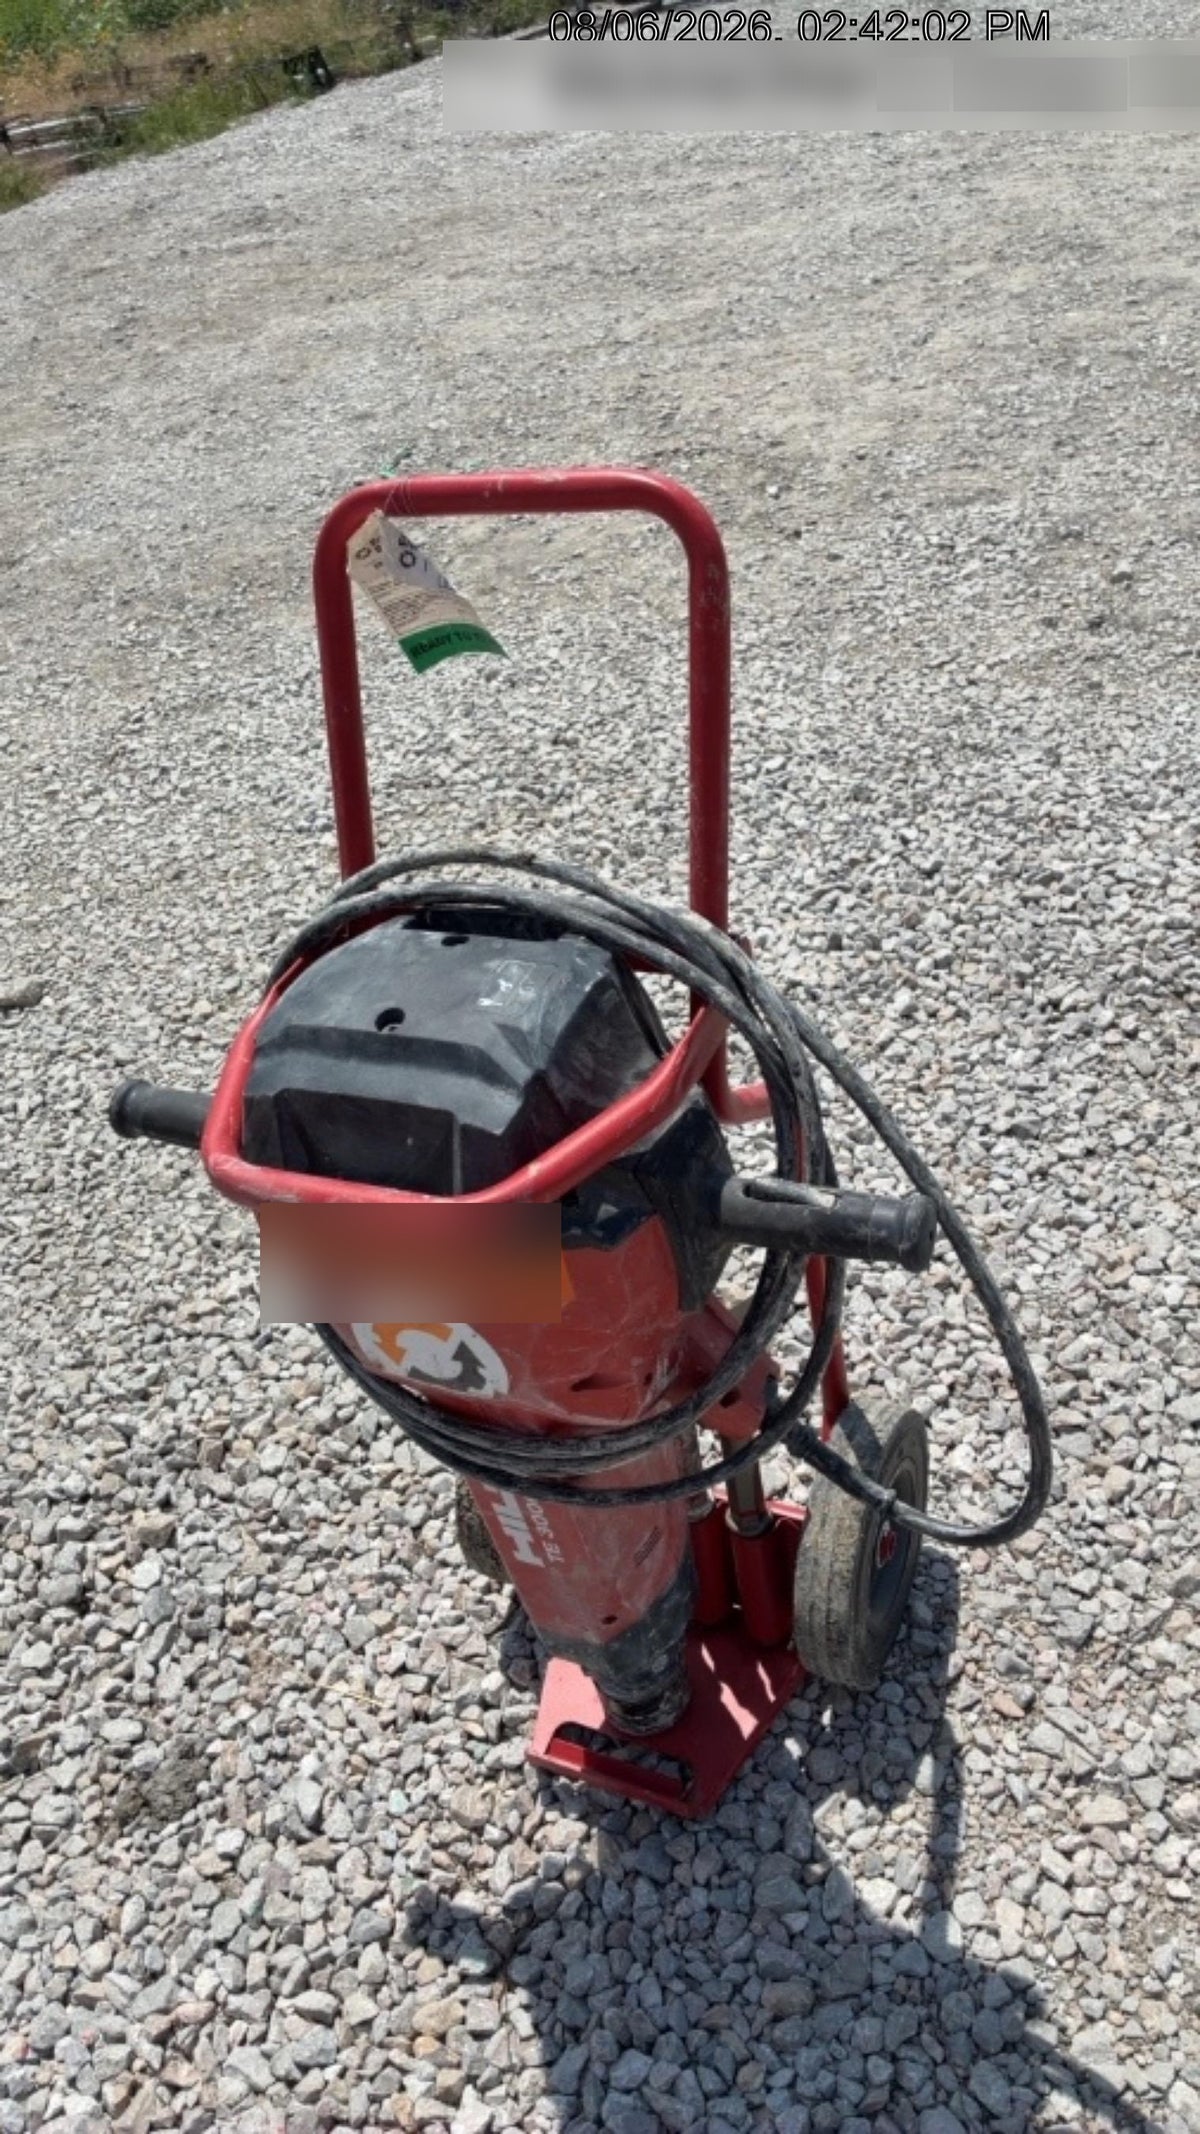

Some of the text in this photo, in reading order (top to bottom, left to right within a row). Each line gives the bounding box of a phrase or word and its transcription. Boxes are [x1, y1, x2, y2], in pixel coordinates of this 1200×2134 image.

[481, 1482, 546, 1568] HIL
[524, 1498, 565, 1563] TE 300
